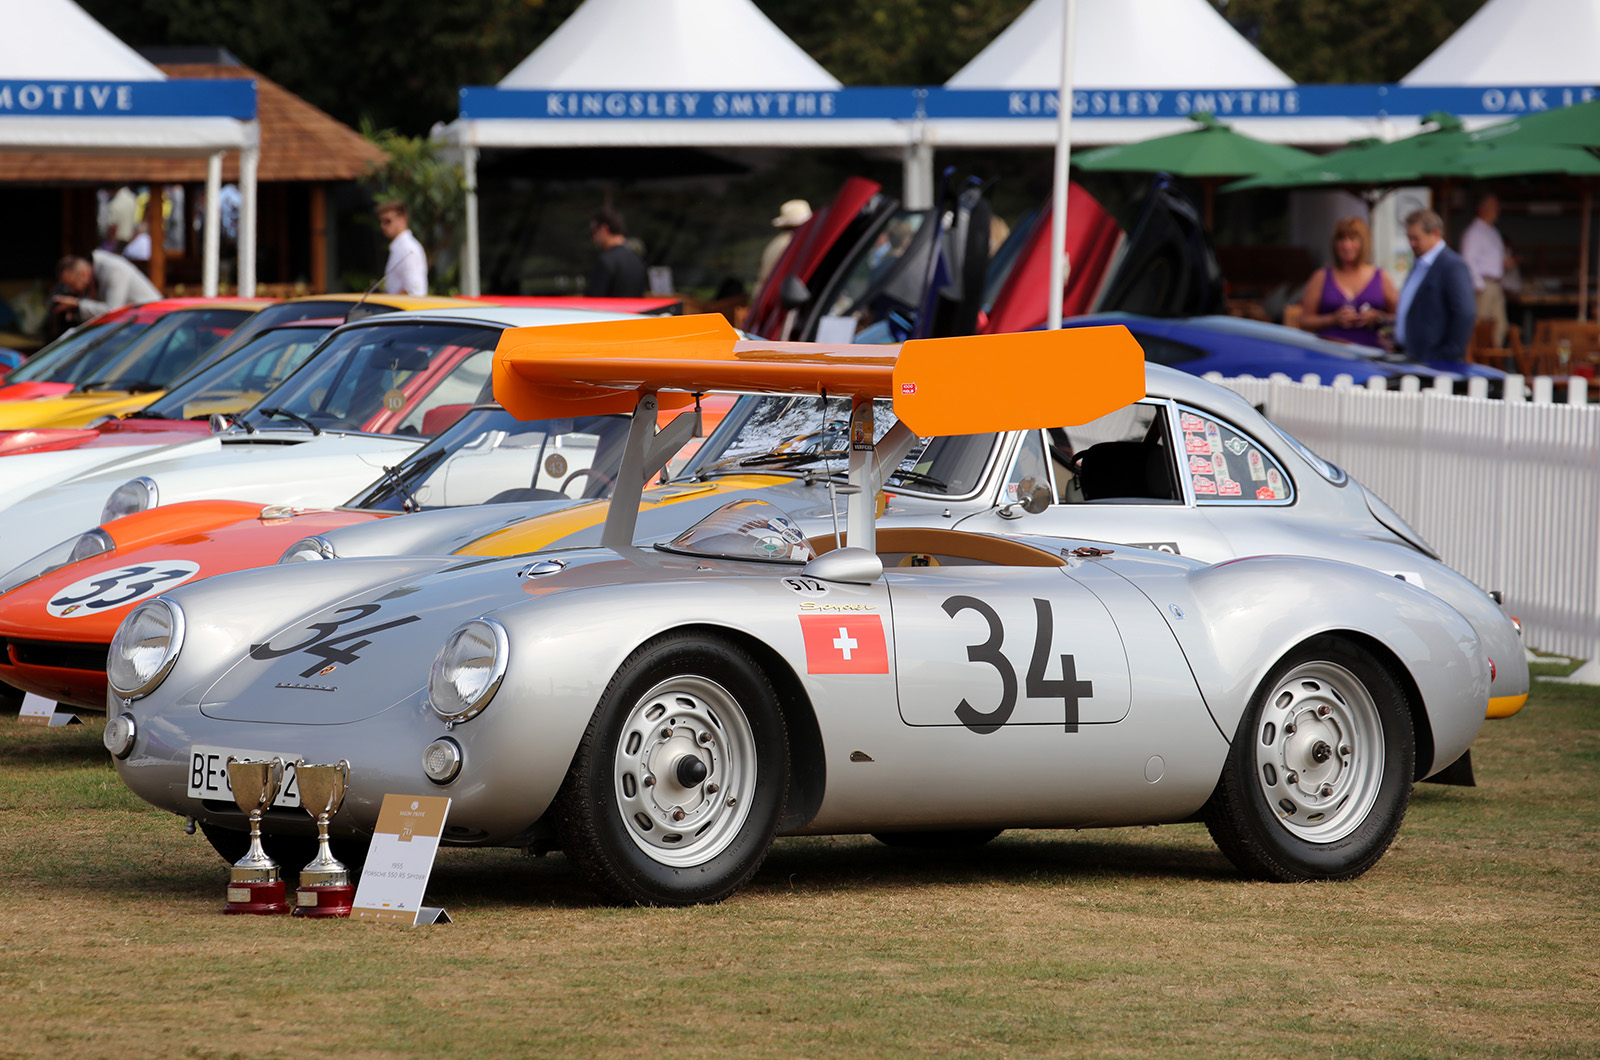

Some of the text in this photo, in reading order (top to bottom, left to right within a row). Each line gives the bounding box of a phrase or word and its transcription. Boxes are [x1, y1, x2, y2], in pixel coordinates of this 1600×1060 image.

[547, 92, 836, 116] KINGSLEY SMYTHE
[1008, 91, 1300, 115] KINGSLEY SMYTHE
[1481, 88, 1548, 112] OAK
[389, 397, 402, 409] 10
[50, 566, 193, 608] 33
[785, 580, 826, 591] 512
[800, 601, 878, 612] Spyder
[250, 603, 422, 679] 34
[941, 595, 1094, 735] 34
